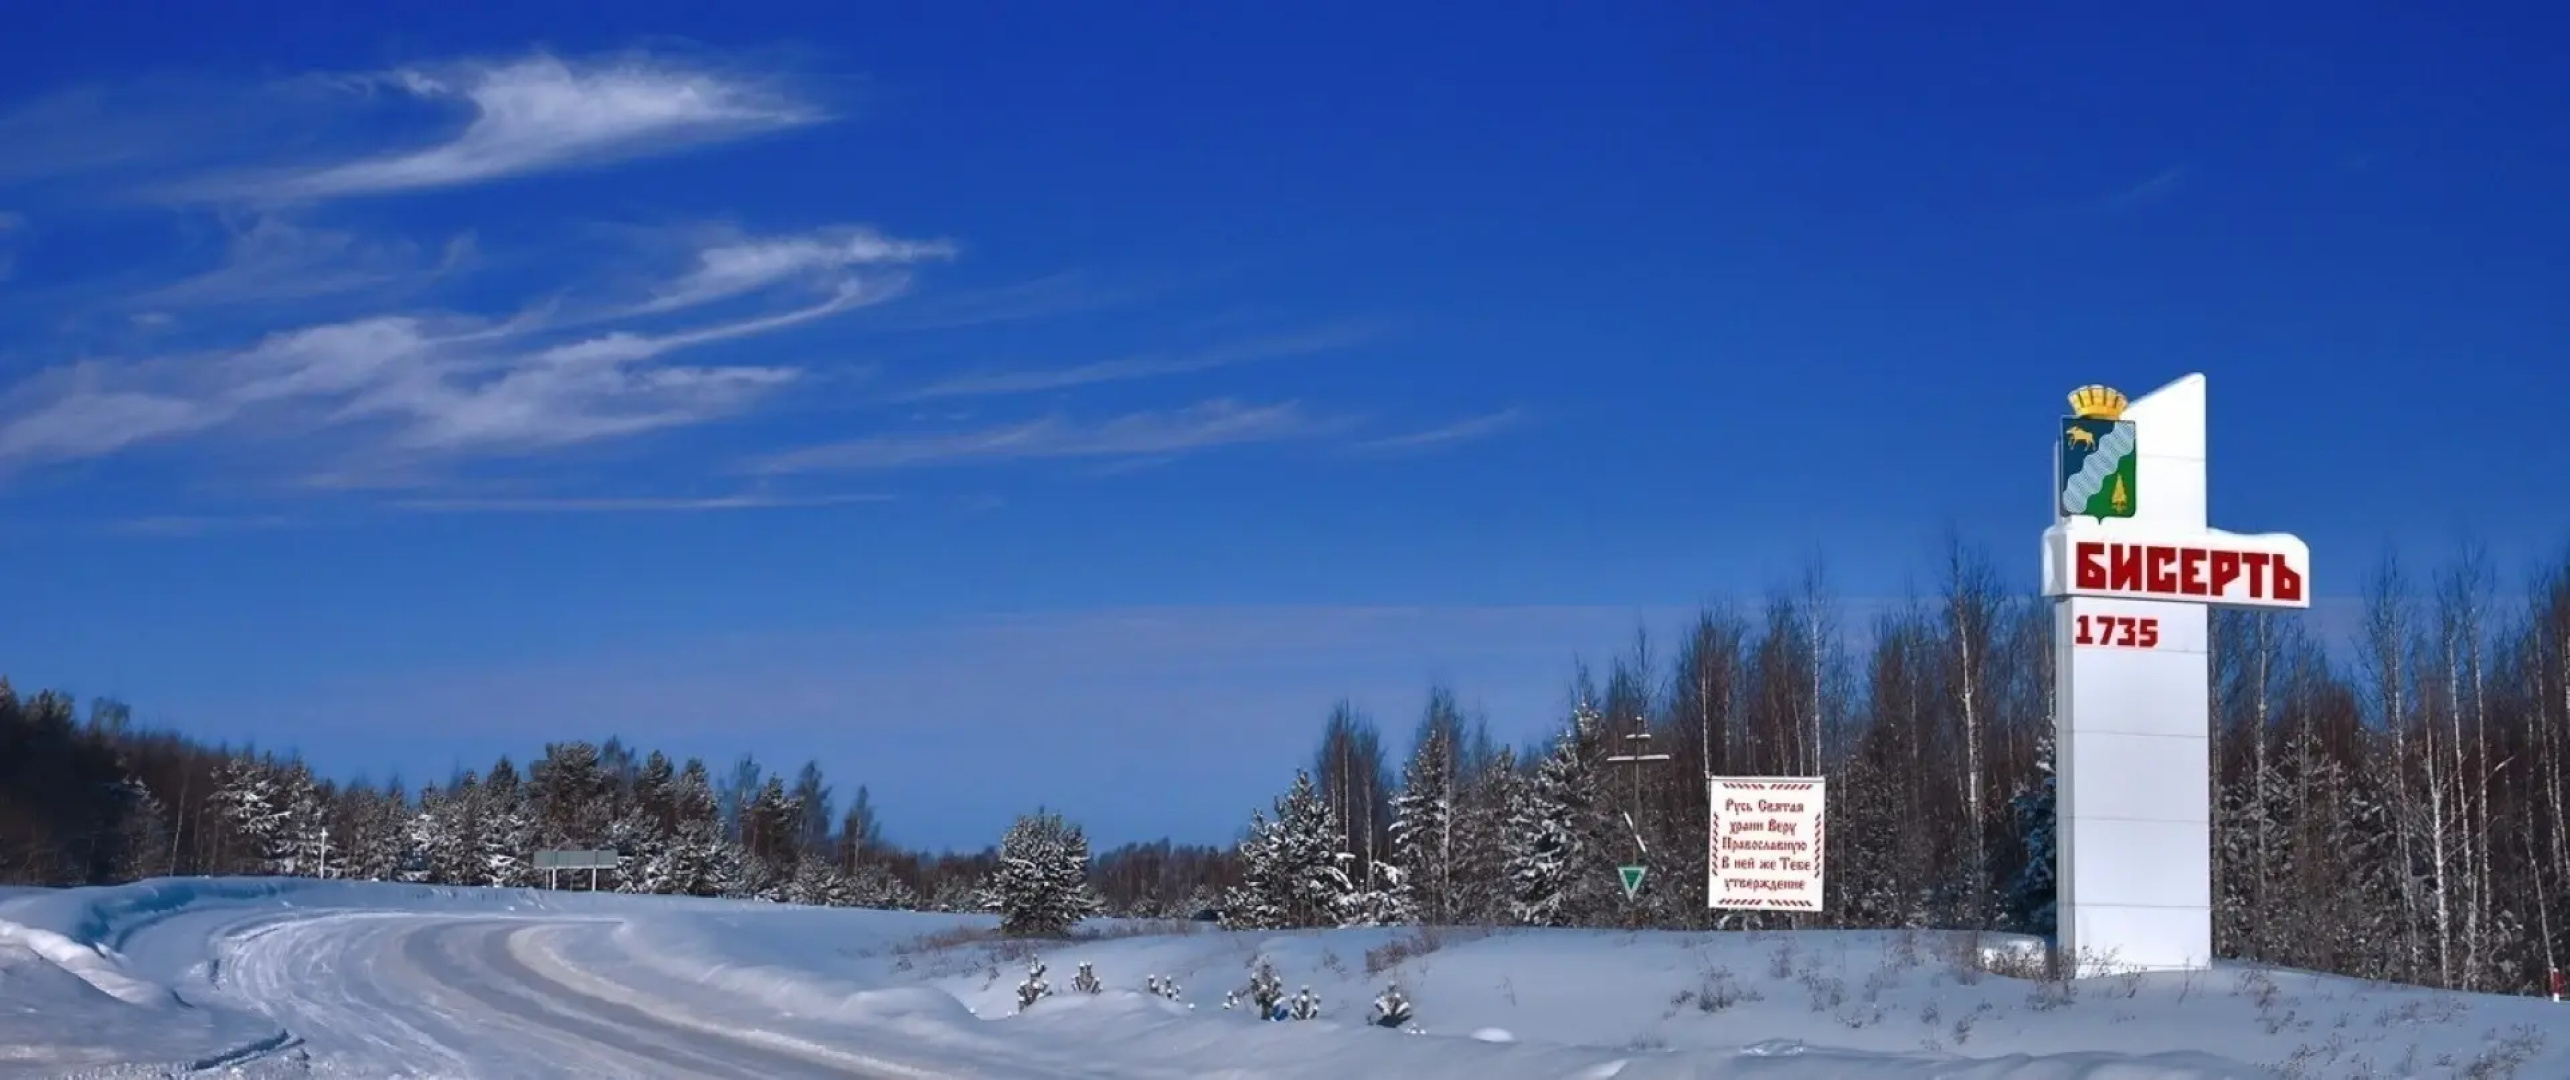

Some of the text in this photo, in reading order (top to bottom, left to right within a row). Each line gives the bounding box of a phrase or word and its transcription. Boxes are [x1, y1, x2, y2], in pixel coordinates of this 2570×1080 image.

[2076, 541, 2301, 601] БИСЕРТЬ
[2075, 615, 2158, 648] 1735
[1725, 798, 1804, 815] Русь Святая
[1729, 819, 1797, 836] храни Веру
[1722, 836, 1808, 855] Православную
[1721, 856, 1811, 871] В ней же Тебе
